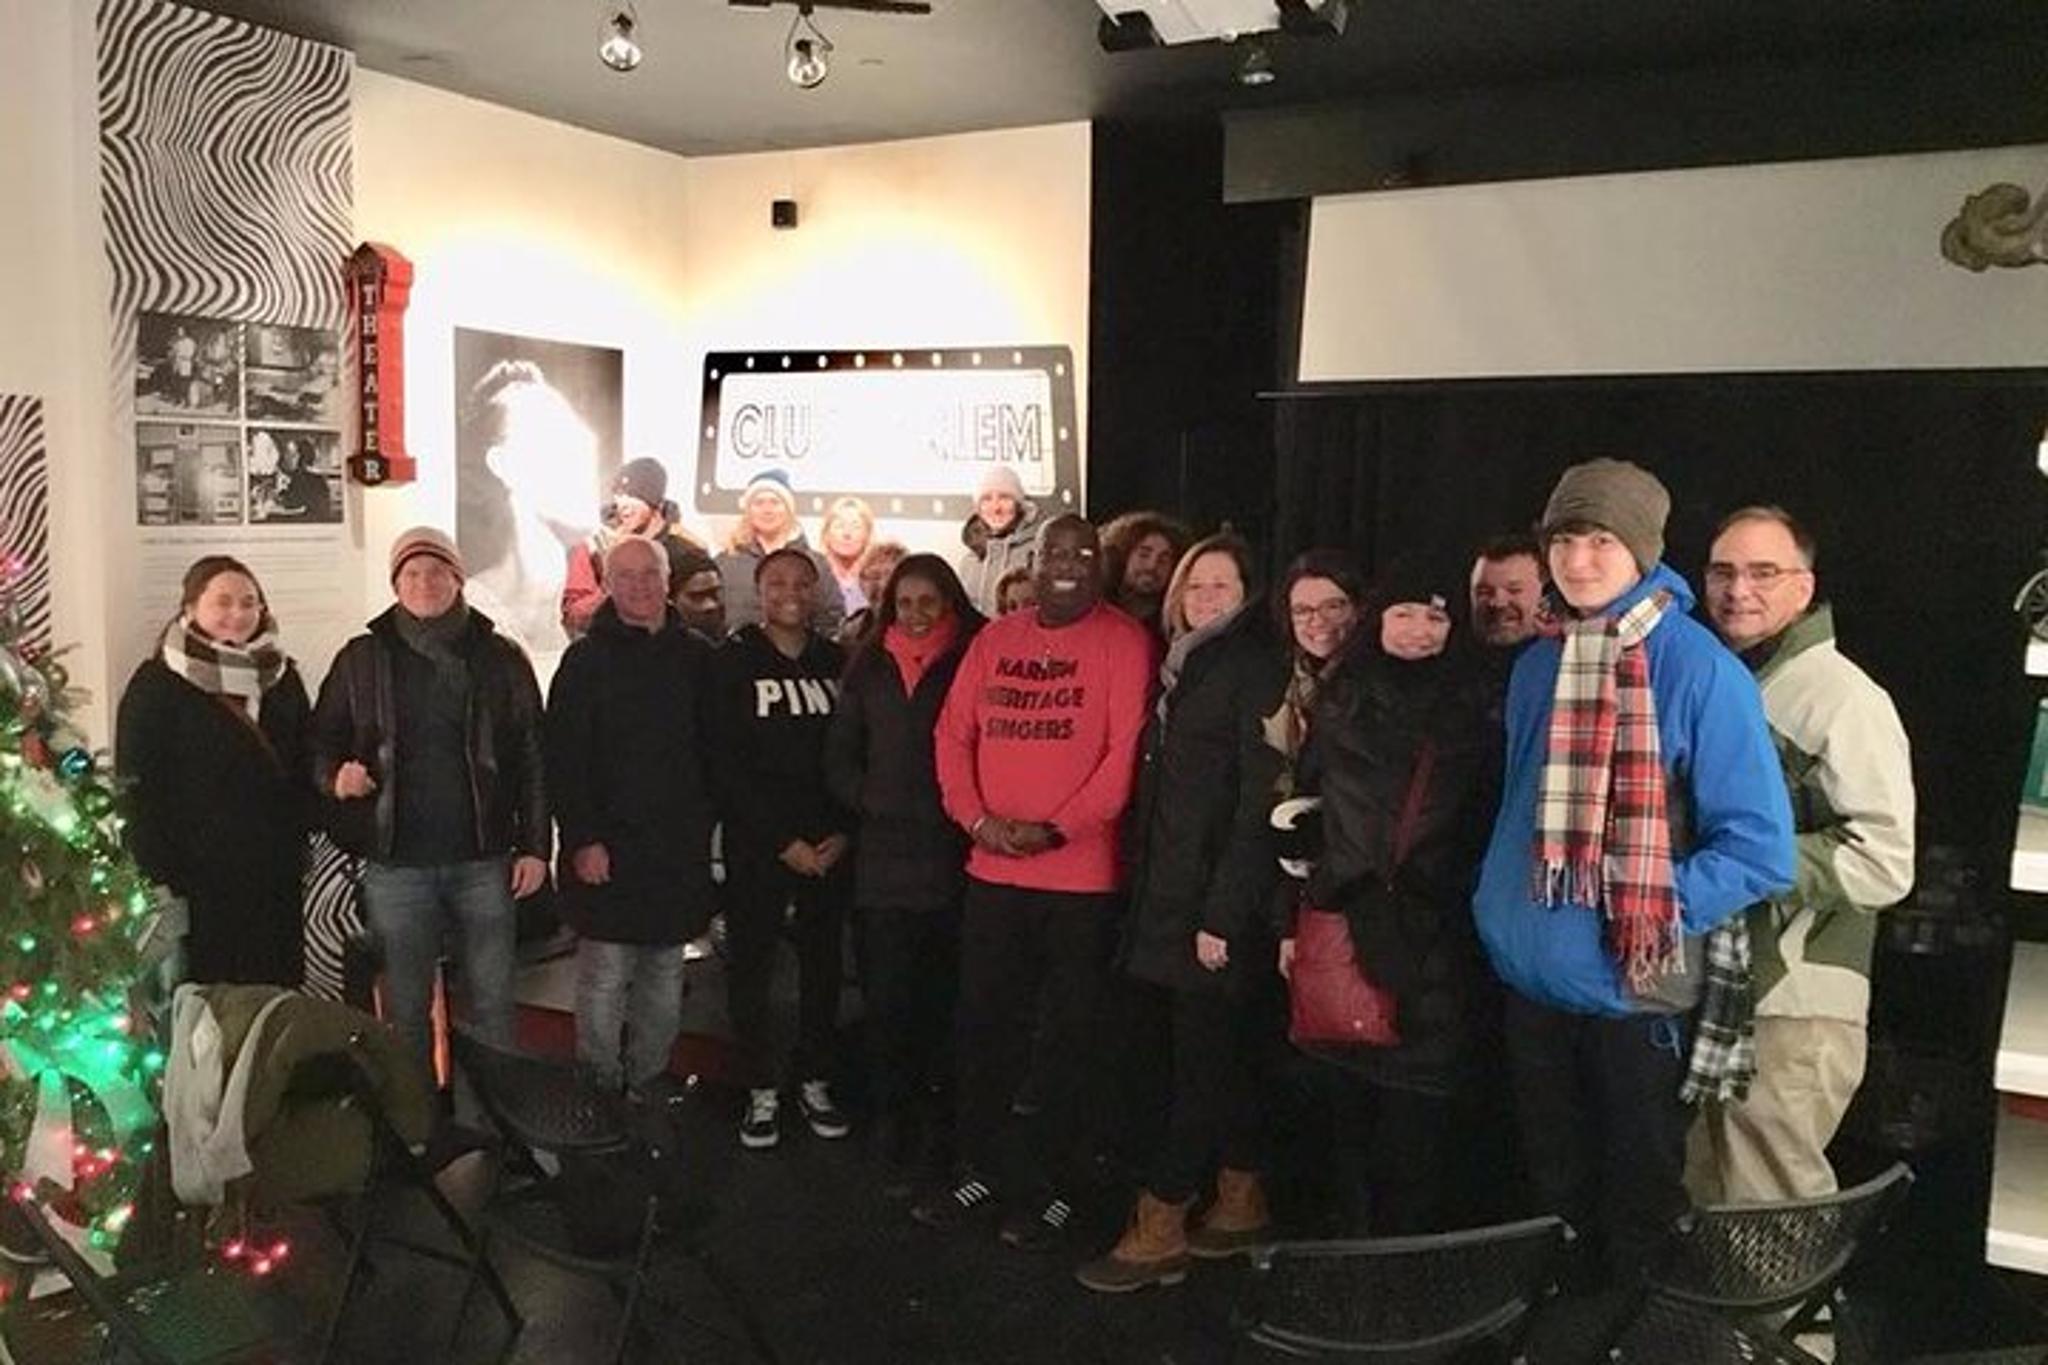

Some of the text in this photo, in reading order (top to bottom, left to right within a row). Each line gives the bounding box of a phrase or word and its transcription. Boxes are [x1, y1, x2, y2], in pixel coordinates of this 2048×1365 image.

[362, 283, 381, 480] THEATER
[731, 402, 1043, 462] CLU LEM
[986, 685, 1085, 710] HERITAGE
[986, 716, 1075, 740] SINGERS
